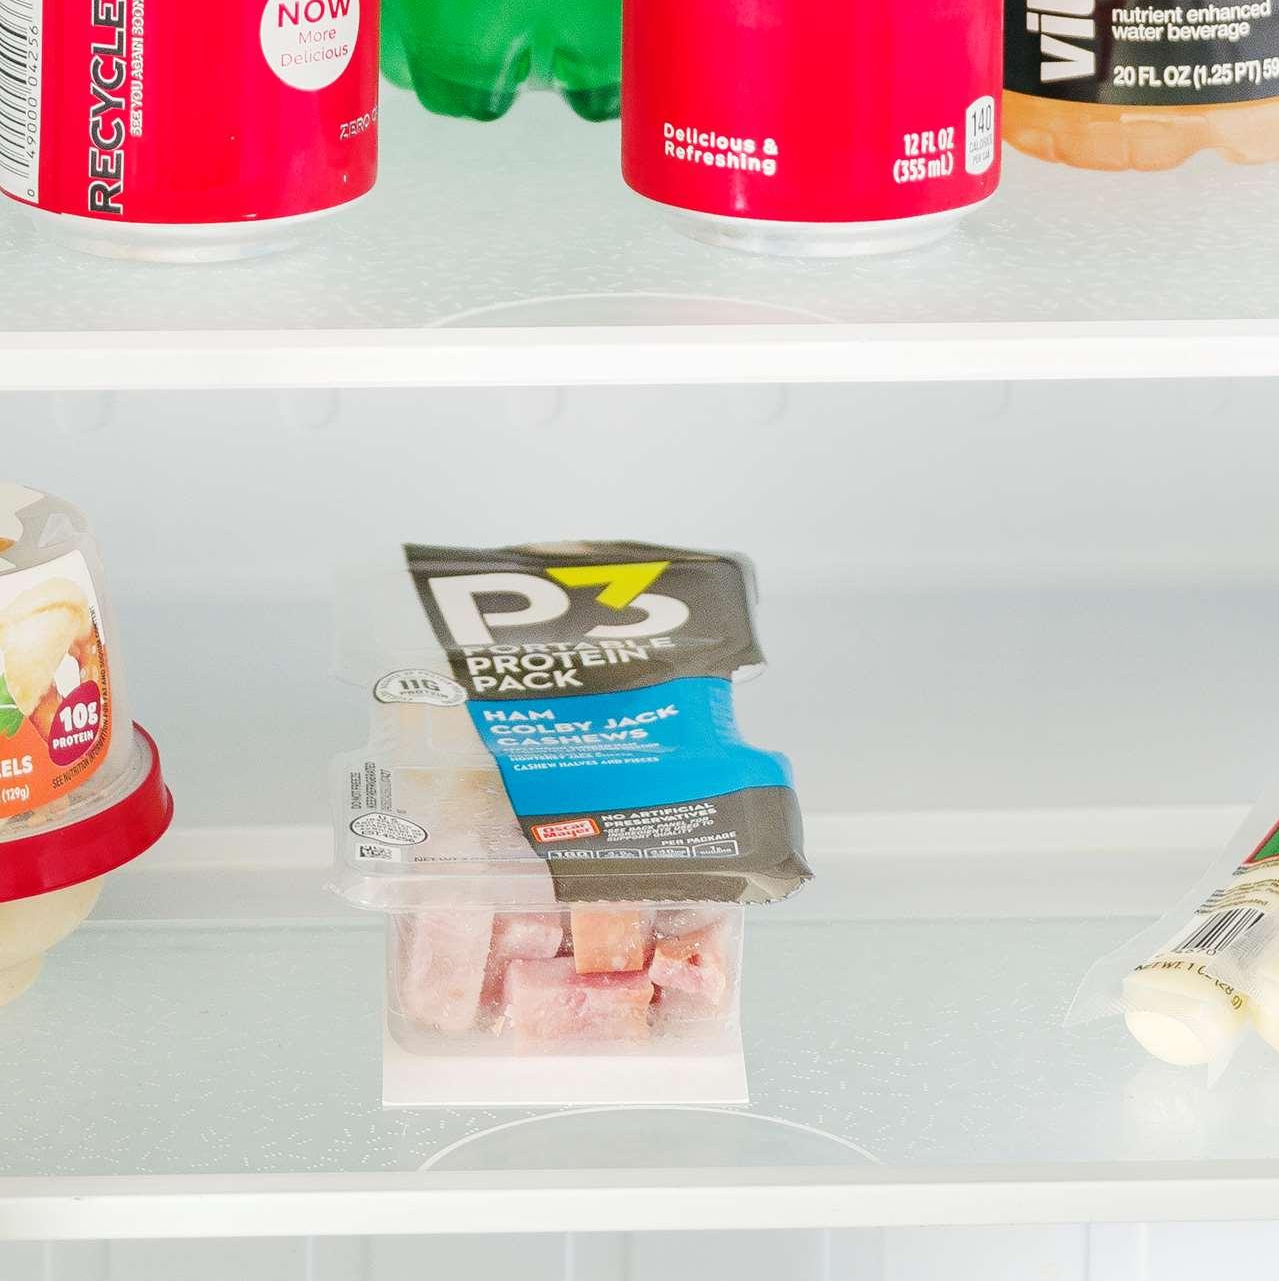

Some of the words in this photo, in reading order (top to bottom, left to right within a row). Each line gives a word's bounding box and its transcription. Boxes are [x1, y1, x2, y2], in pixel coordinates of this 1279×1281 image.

[1111, 5, 1183, 24] nutrient
[298, 28, 336, 45] More
[1111, 24, 1161, 41] water
[1167, 21, 1251, 42] beverage
[28, 25, 40, 87] 04256
[131, 38, 144, 80] AGAIN
[281, 44, 349, 67] Delicious
[1113, 65, 1136, 87] 20
[1138, 66, 1161, 87] FL
[1163, 65, 1192, 88] OZ
[1193, 62, 1234, 90] (1.25
[1235, 59, 1261, 86] PT)
[130, 80, 143, 109] YOU
[27, 97, 38, 159] 49000
[130, 109, 143, 137] SEE
[340, 113, 370, 140] ZERO
[972, 104, 992, 137] 140
[663, 122, 756, 156] Delicious
[762, 137, 779, 156] &
[904, 133, 920, 156] 12
[921, 130, 936, 154] FL
[938, 126, 954, 150] OZ
[664, 141, 777, 176] Refreshing
[894, 157, 926, 183] (355
[927, 150, 954, 178] mL)
[428, 561, 690, 645] P3
[466, 648, 650, 675] PROTEIN
[471, 669, 584, 692] PACK
[59, 700, 99, 733] 10g
[483, 709, 556, 722] HAM
[489, 721, 592, 735] COLBY
[604, 704, 679, 730] JACK
[52, 729, 94, 751] PROTEIN
[496, 728, 650, 747] CASHEWS
[513, 763, 557, 772] CASHEW
[559, 760, 599, 769] HALVES
[51, 772, 64, 789] SEE
[601, 813, 626, 821] NO
[630, 803, 715, 819] ARTIFICIAL
[604, 808, 718, 828] PRESERVATIVES
[542, 823, 585, 833] Oscar
[542, 828, 590, 839] Mayer
[687, 831, 737, 844] PACKAGE
